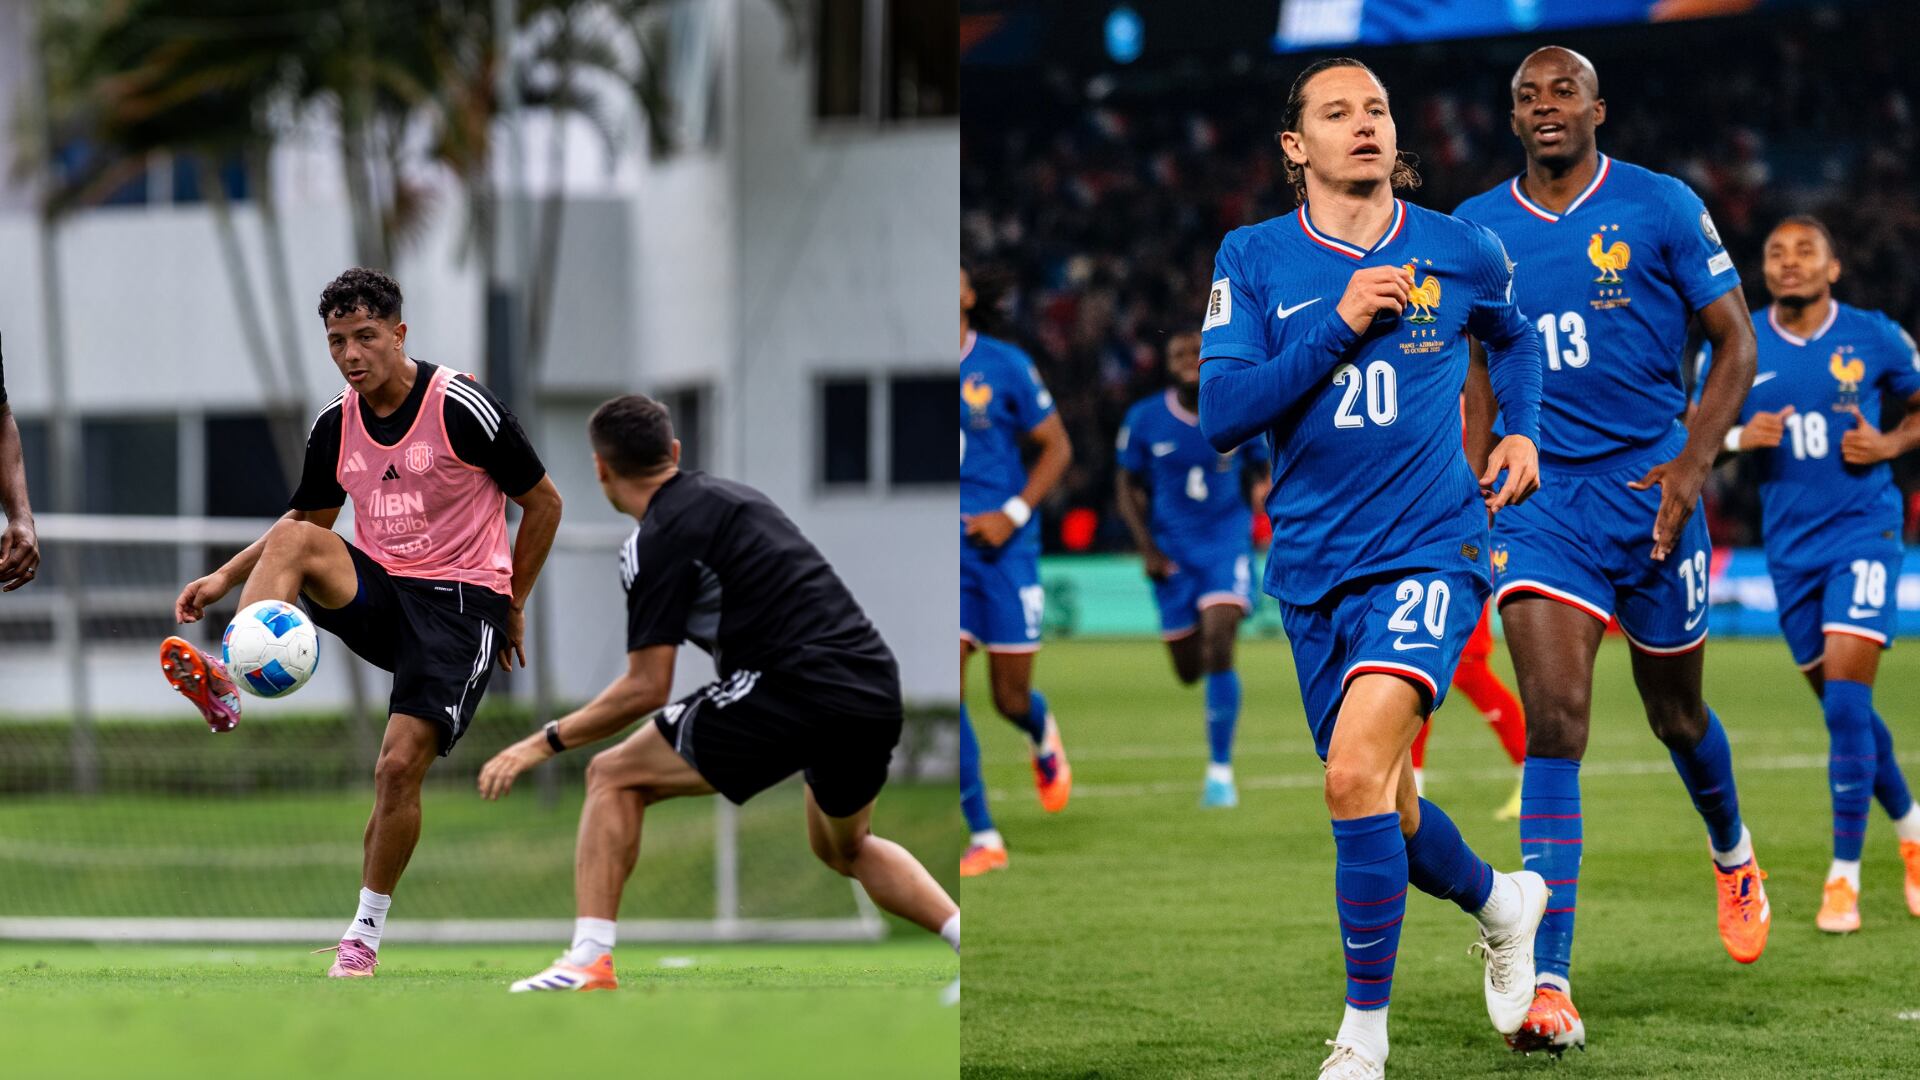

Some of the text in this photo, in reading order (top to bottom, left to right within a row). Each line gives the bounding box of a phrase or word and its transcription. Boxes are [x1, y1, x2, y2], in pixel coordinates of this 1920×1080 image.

[1538, 311, 1590, 371] 13
[1332, 360, 1398, 429] 20
[1786, 411, 1829, 461] 18
[386, 514, 429, 535] kölbi
[1388, 579, 1451, 640] 20
[1678, 550, 1706, 612] 13
[1850, 559, 1887, 609] 18
